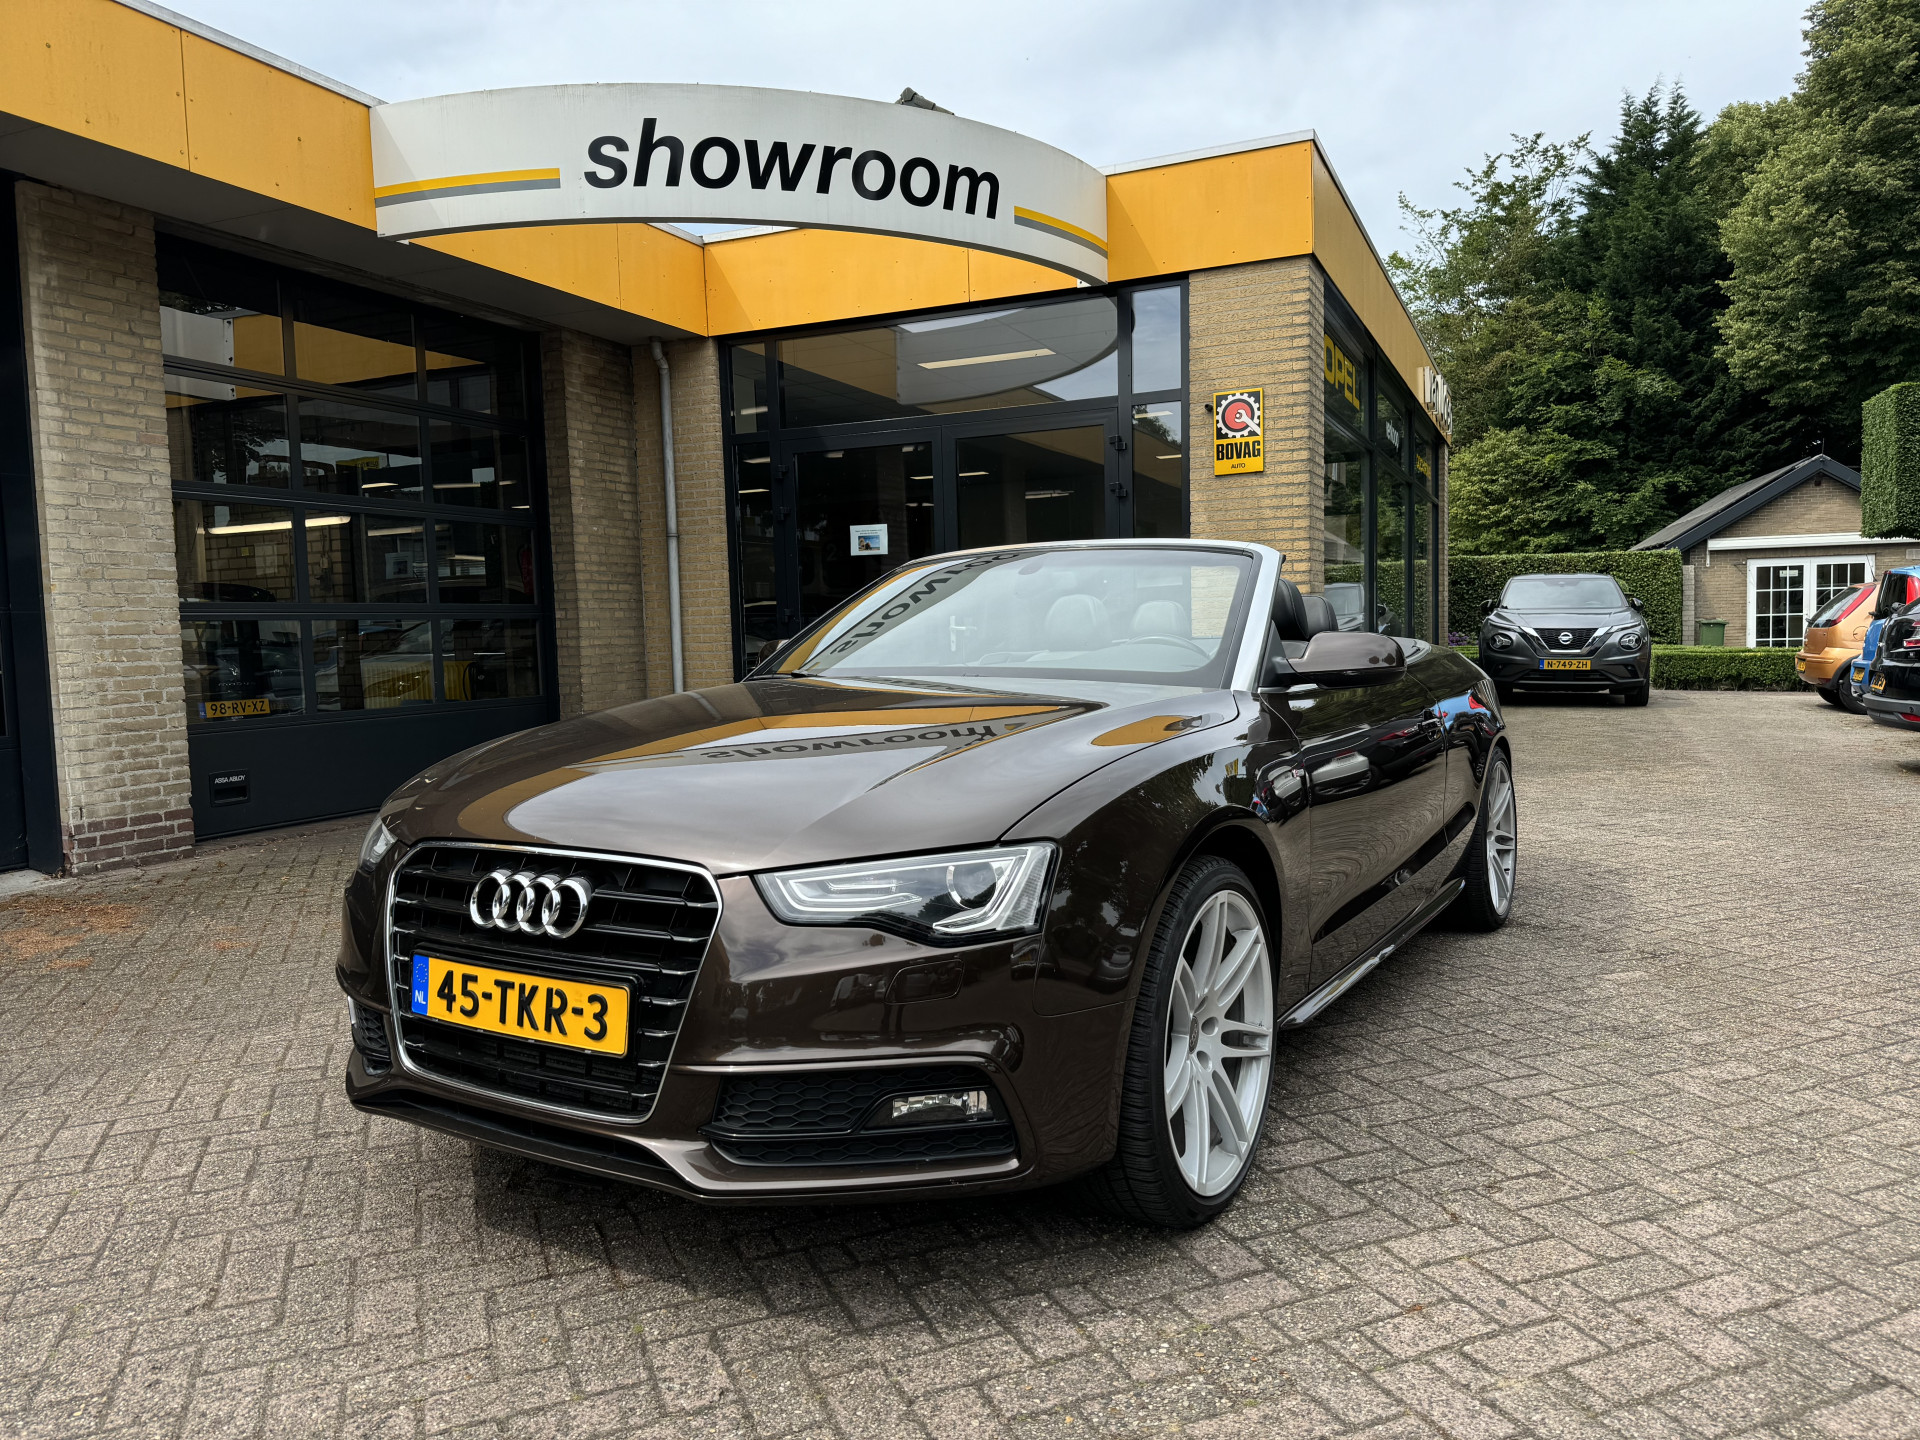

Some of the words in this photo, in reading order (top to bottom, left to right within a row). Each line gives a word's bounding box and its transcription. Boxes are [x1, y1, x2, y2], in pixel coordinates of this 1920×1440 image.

[583, 117, 1001, 220] showroom
[1324, 333, 1360, 411] OPEL
[1216, 440, 1261, 461] BOVAG
[1231, 462, 1246, 470] AUTO
[1547, 660, 1588, 669] N-749-ZH
[210, 700, 266, 716] 98-RV-XZ
[229, 774, 246, 782] ABLOY
[414, 989, 426, 1005] NL
[437, 969, 608, 1042] 45-TKR-3
